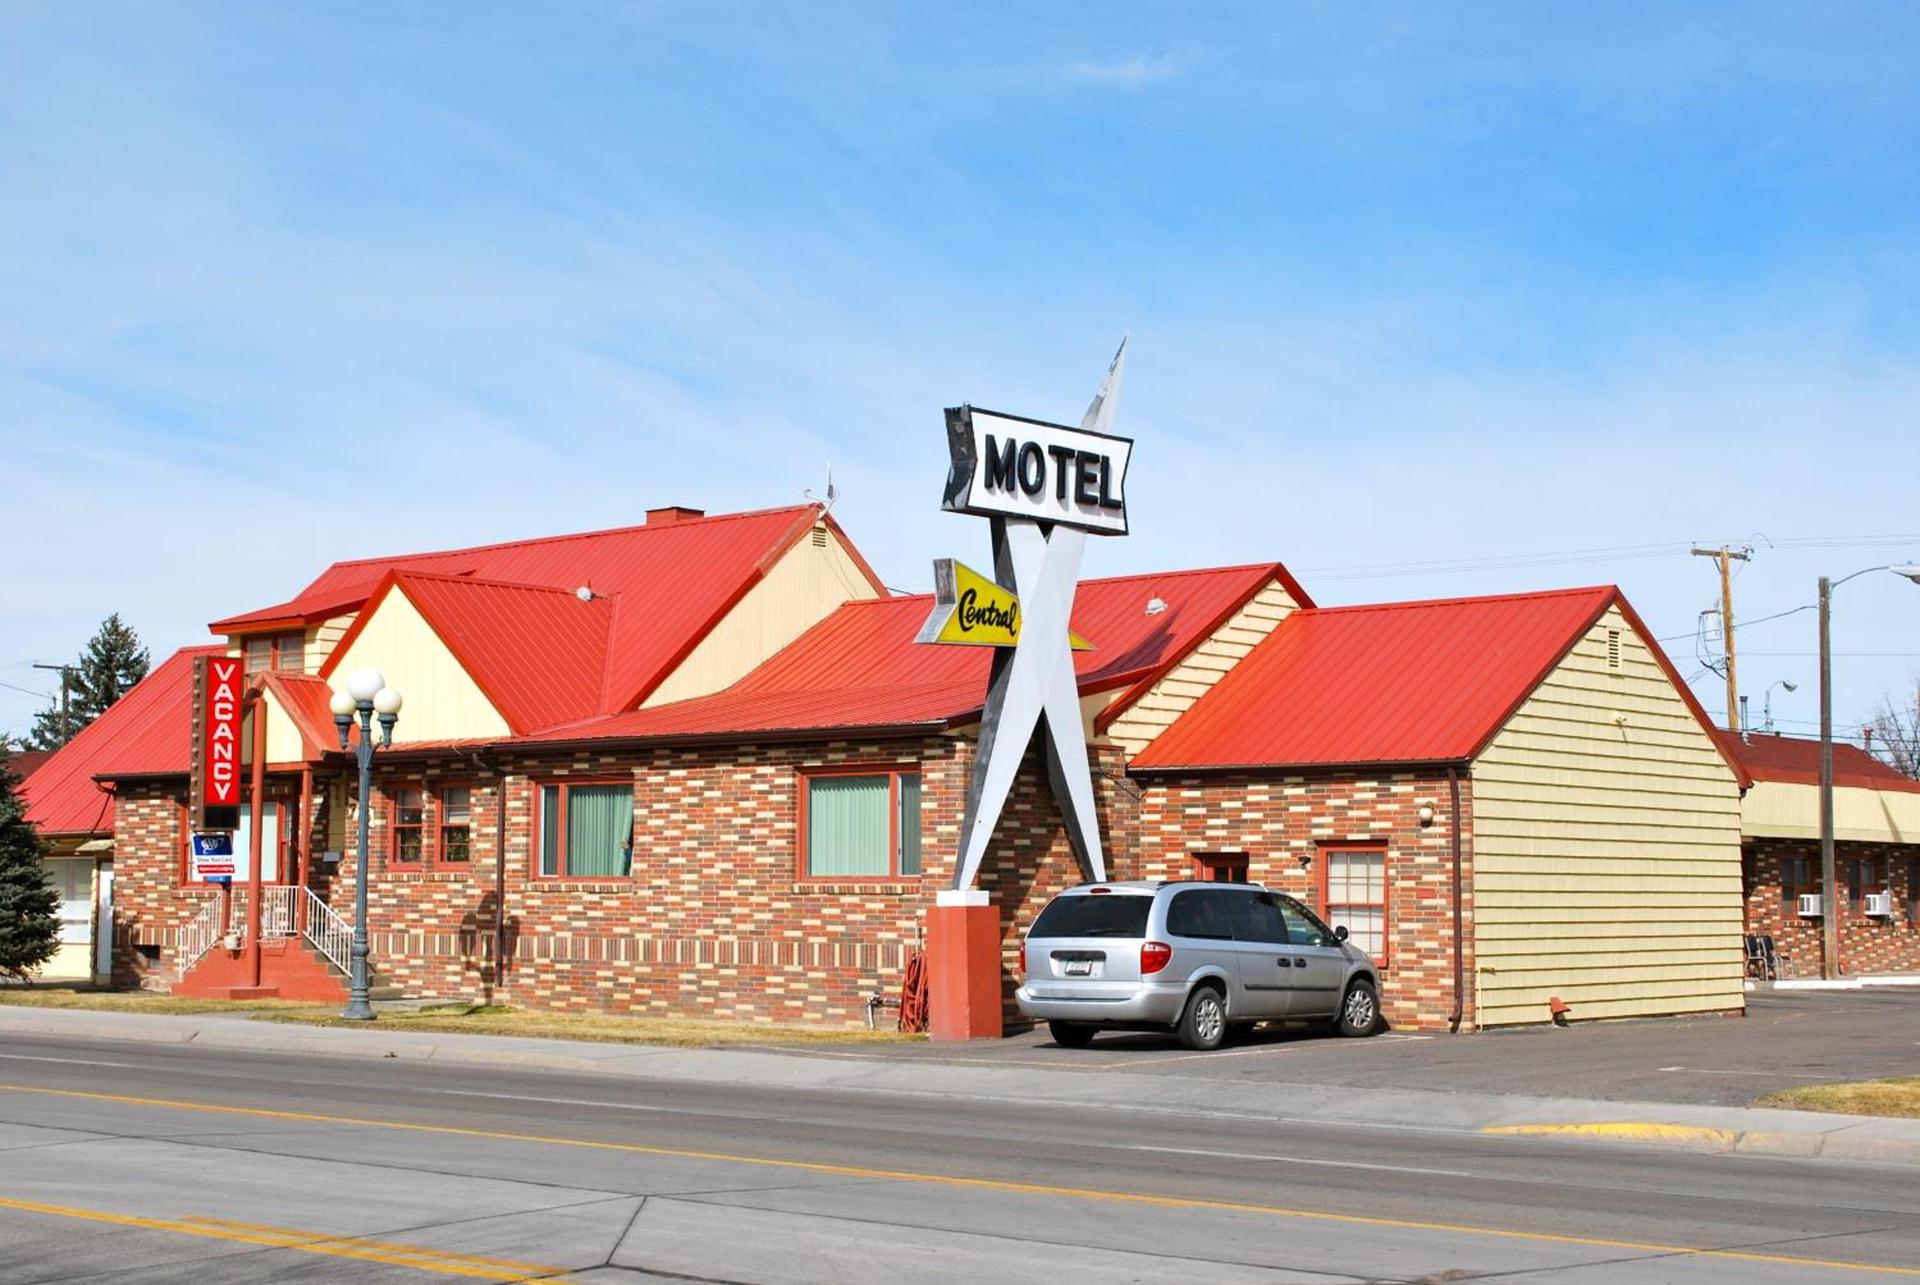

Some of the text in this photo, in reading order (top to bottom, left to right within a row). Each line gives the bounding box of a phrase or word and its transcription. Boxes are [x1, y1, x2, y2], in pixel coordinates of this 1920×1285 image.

[984, 434, 1122, 509] MOTEL
[958, 588, 1017, 636] Central
[213, 663, 236, 800] VACANCY
